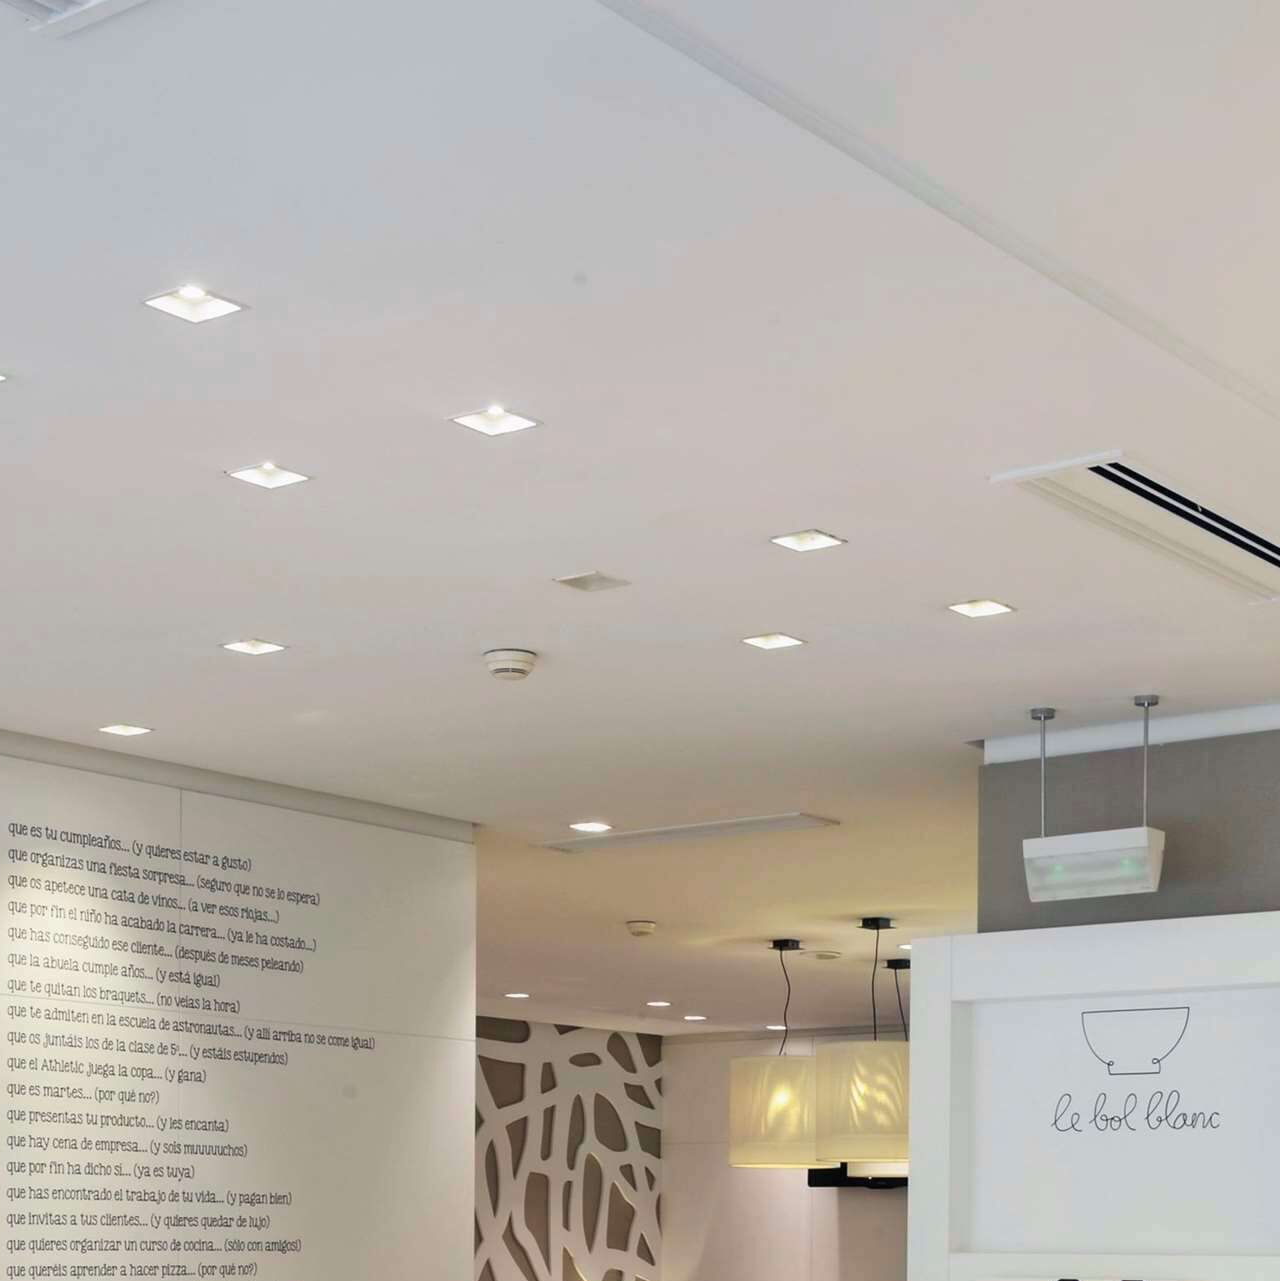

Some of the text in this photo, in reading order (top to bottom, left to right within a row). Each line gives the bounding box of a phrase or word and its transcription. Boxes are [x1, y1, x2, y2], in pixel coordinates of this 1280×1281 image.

[8, 822, 28, 836] que
[8, 849, 28, 863] que
[30, 852, 83, 870] organizas
[86, 860, 106, 873] una
[109, 861, 139, 878] fiesta
[8, 874, 28, 888] que
[44, 880, 86, 896] apetece
[88, 886, 108, 899] una
[111, 889, 135, 902] cata
[8, 900, 28, 914] que
[30, 903, 47, 917] por
[51, 903, 66, 918] fin
[80, 908, 102, 923] niño
[121, 915, 165, 931] acabado
[8, 927, 27, 941] que
[30, 927, 50, 942] has
[53, 932, 109, 950] conseguido
[112, 940, 129, 952] ese
[8, 953, 27, 967] que
[43, 954, 79, 971] abuela
[82, 961, 118, 977] cumple
[8, 979, 27, 993] que
[44, 981, 80, 997] quitan
[83, 983, 97, 998] los
[7, 1005, 26, 1019] que
[44, 1006, 90, 1023] admiten
[119, 1015, 156, 1029] escuela
[7, 1031, 26, 1045] que
[43, 1031, 83, 1048] juntáis
[85, 1035, 99, 1049] los
[128, 1039, 155, 1054] clase
[7, 1057, 26, 1071] que
[41, 1057, 84, 1073] Athletic
[87, 1060, 115, 1078] juega
[7, 1083, 26, 1097] que
[7, 1109, 26, 1123] que
[29, 1110, 83, 1124] presentas
[1089, 1092, 1137, 1131] bol
[1144, 1090, 1220, 1130] blanc
[7, 1136, 26, 1150] que
[28, 1134, 50, 1151] hay
[52, 1138, 78, 1149] cena
[7, 1159, 111, 1176] que por fin dicho
[7, 1187, 26, 1201] que
[28, 1185, 49, 1199] has
[52, 1186, 111, 1200] encontrado
[126, 1187, 166, 1205] trabajo
[7, 1213, 26, 1227] que
[28, 1210, 67, 1225] invitas
[80, 1212, 97, 1225] tus
[7, 1240, 26, 1254] que
[28, 1237, 67, 1254] quieres
[69, 1237, 122, 1254] organizar
[139, 1240, 168, 1251] curso
[7, 1265, 26, 1279] que
[29, 1262, 68, 1279] queréis
[71, 1262, 117, 1279] aprender
[130, 1262, 159, 1276] hacer
